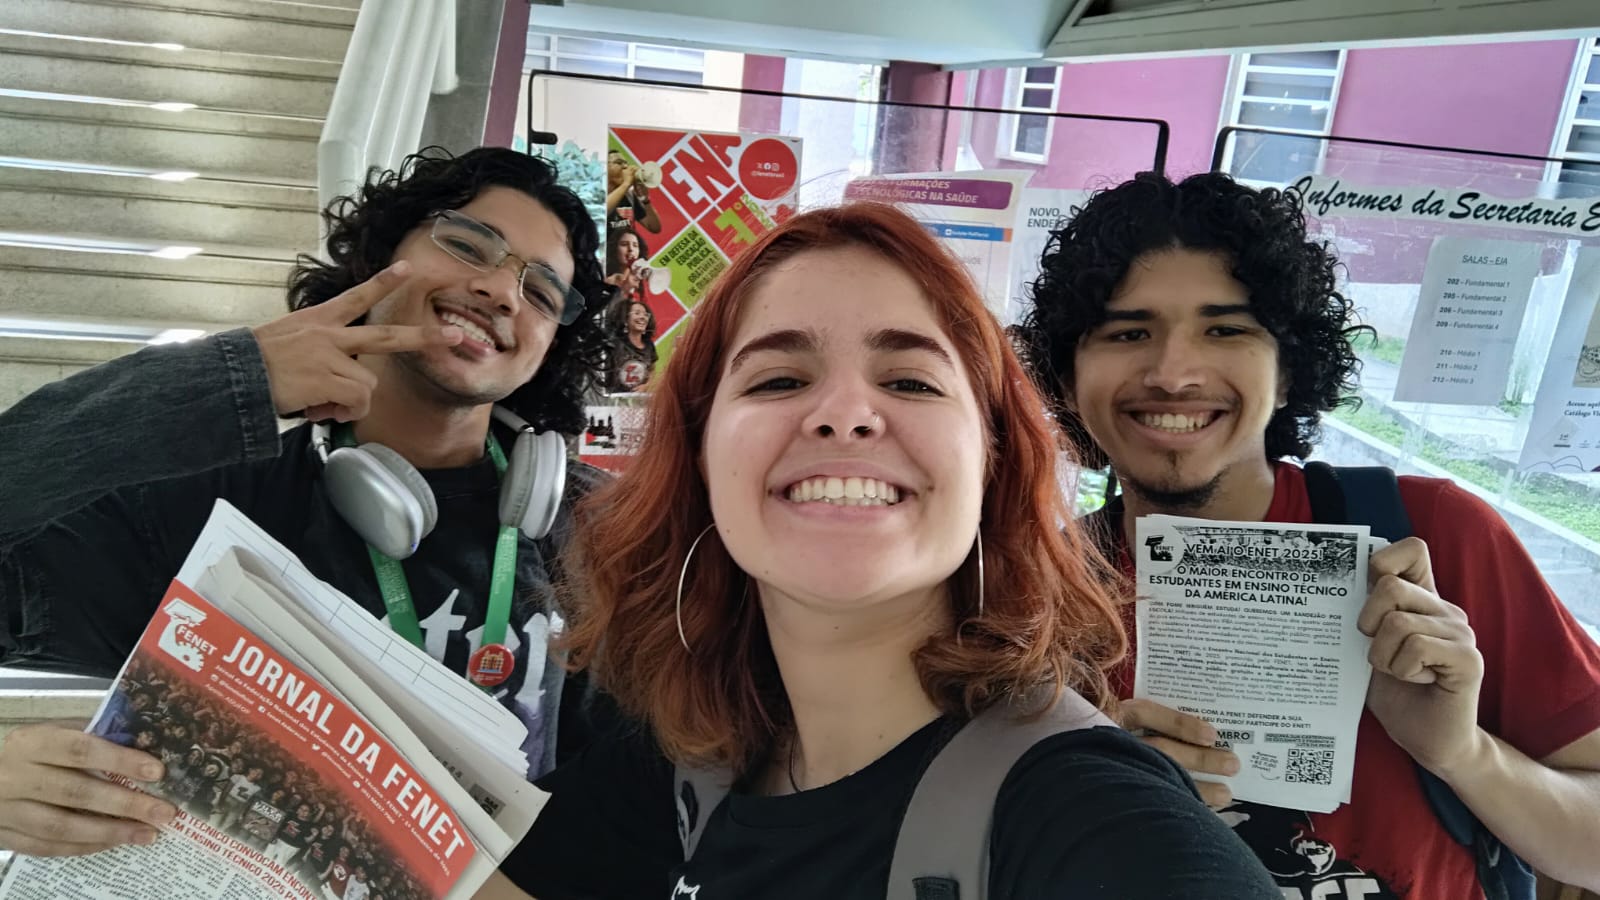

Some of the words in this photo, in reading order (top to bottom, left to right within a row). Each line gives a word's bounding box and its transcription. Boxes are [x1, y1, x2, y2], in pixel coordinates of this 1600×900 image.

[1029, 207, 1060, 217] NOVO
[1296, 175, 1403, 217] Informes
[1411, 189, 1446, 215] da
[1448, 191, 1578, 229] Secretaria
[1461, 254, 1489, 265] SALAS
[1186, 544, 1213, 554] VEM
[1247, 547, 1279, 557] ENET
[1283, 548, 1323, 560] 2025!
[1177, 565, 1187, 575] O
[1189, 567, 1228, 577] MAIOR
[1232, 569, 1300, 581] ENCONTRO
[1302, 573, 1318, 583] DE
[1149, 575, 1222, 588] ESTUDANTES
[1225, 579, 1242, 590] EM
[1244, 581, 1290, 593] ENSINO
[1292, 582, 1348, 597] TÉCNICO
[1185, 588, 1201, 598] DA
[1203, 588, 1257, 602] AMÉRICA
[1260, 593, 1308, 606] LATINA!
[176, 624, 218, 656] FENET
[222, 636, 334, 735] JORNAL
[340, 723, 381, 774] DA
[382, 763, 465, 859] FENET
[184, 827, 222, 854] ENSINO
[261, 871, 287, 897] 2025
[230, 836, 285, 876] CONVOCAM
